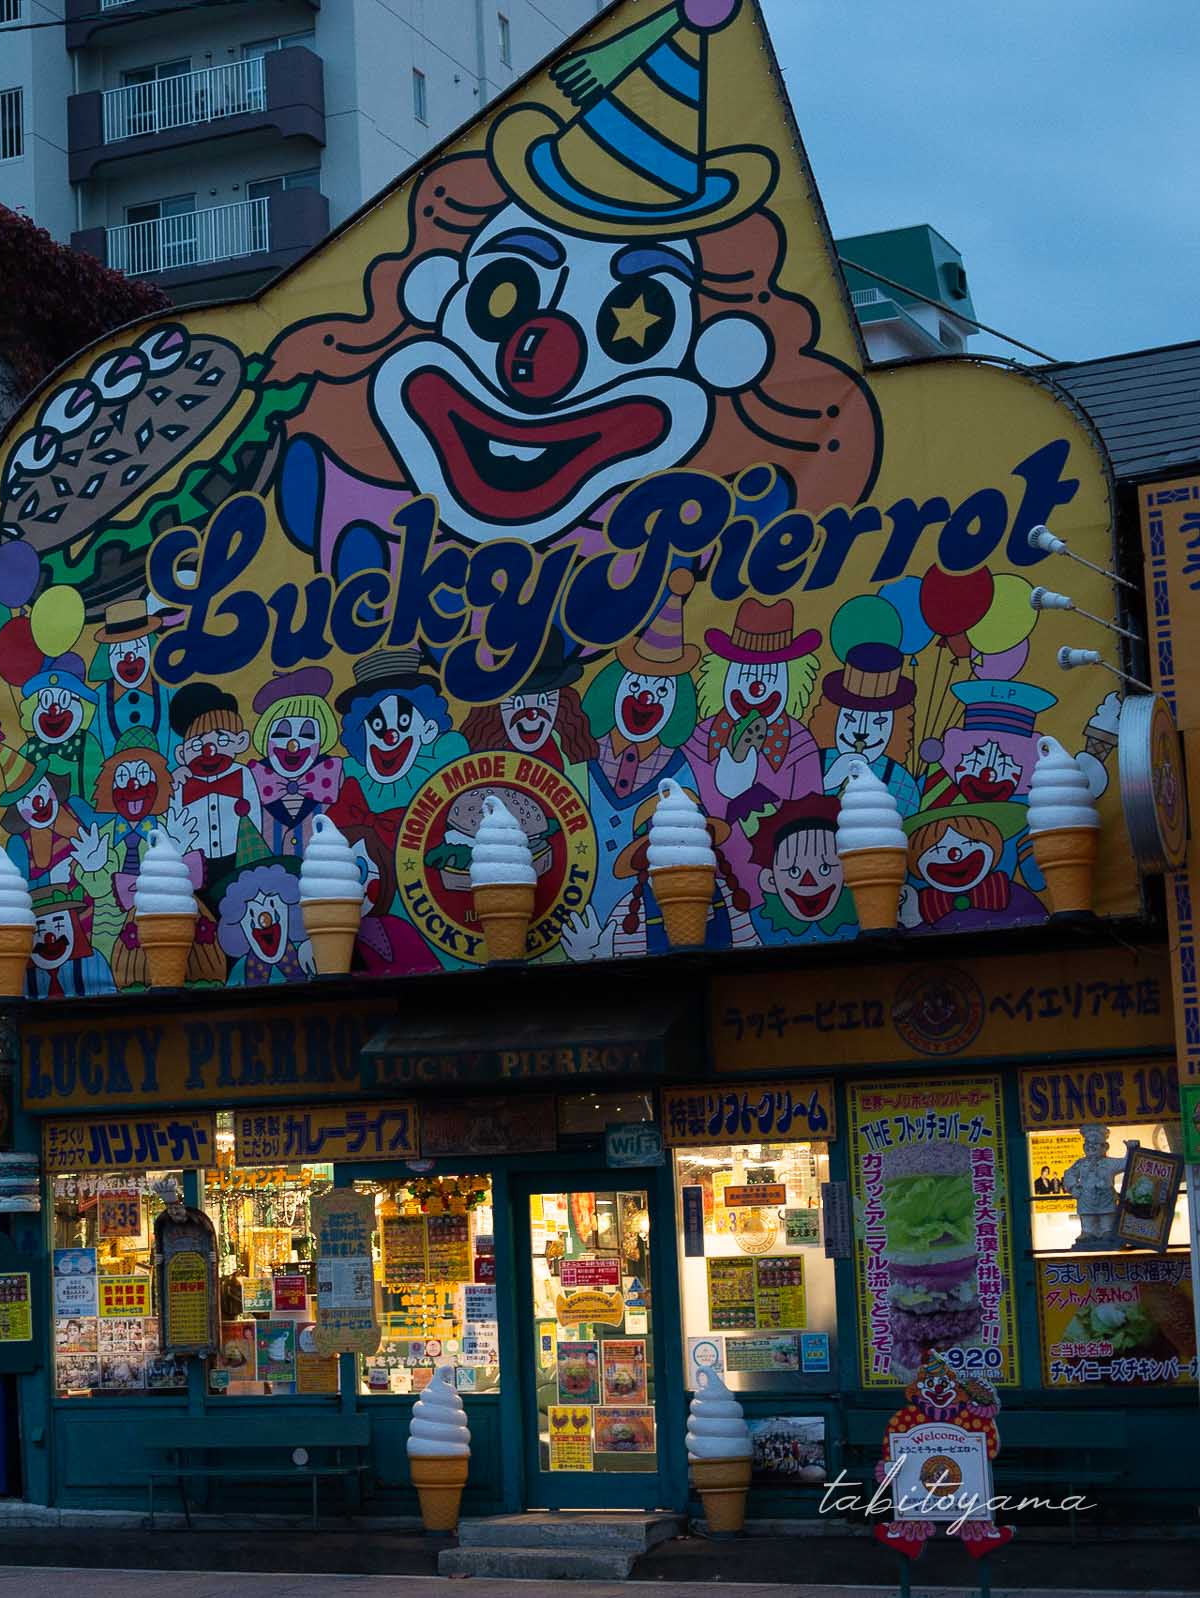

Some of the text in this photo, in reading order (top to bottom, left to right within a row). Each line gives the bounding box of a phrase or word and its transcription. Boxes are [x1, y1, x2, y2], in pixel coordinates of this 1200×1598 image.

[148, 490, 576, 704] Lucky
[564, 439, 1080, 649] Pierrot
[401, 756, 589, 850] HOME MADE BURGER
[404, 864, 590, 956] LUCKY ERROT
[722, 999, 885, 1040] ラッキーピエロ
[989, 981, 1161, 1022] ベイエリア本店
[26, 1026, 165, 1099] LUCKY
[668, 1098, 706, 1139] 特製
[706, 1088, 830, 1136] ソフトクリーム
[1029, 1073, 1125, 1122] SINCE
[48, 1126, 84, 1146] 手づくり
[87, 1120, 208, 1165] ハンバーガー
[241, 1117, 281, 1137] 自家製
[242, 1137, 280, 1157] こだわり
[284, 1109, 412, 1154] カレーライス
[860, 1112, 993, 1151] THE フトッチョバーガー
[48, 1146, 86, 1167] デカウマ
[948, 1347, 1002, 1369] 920
[1050, 1342, 1114, 1358] ご当地名物
[911, 1431, 966, 1445] Welcome
